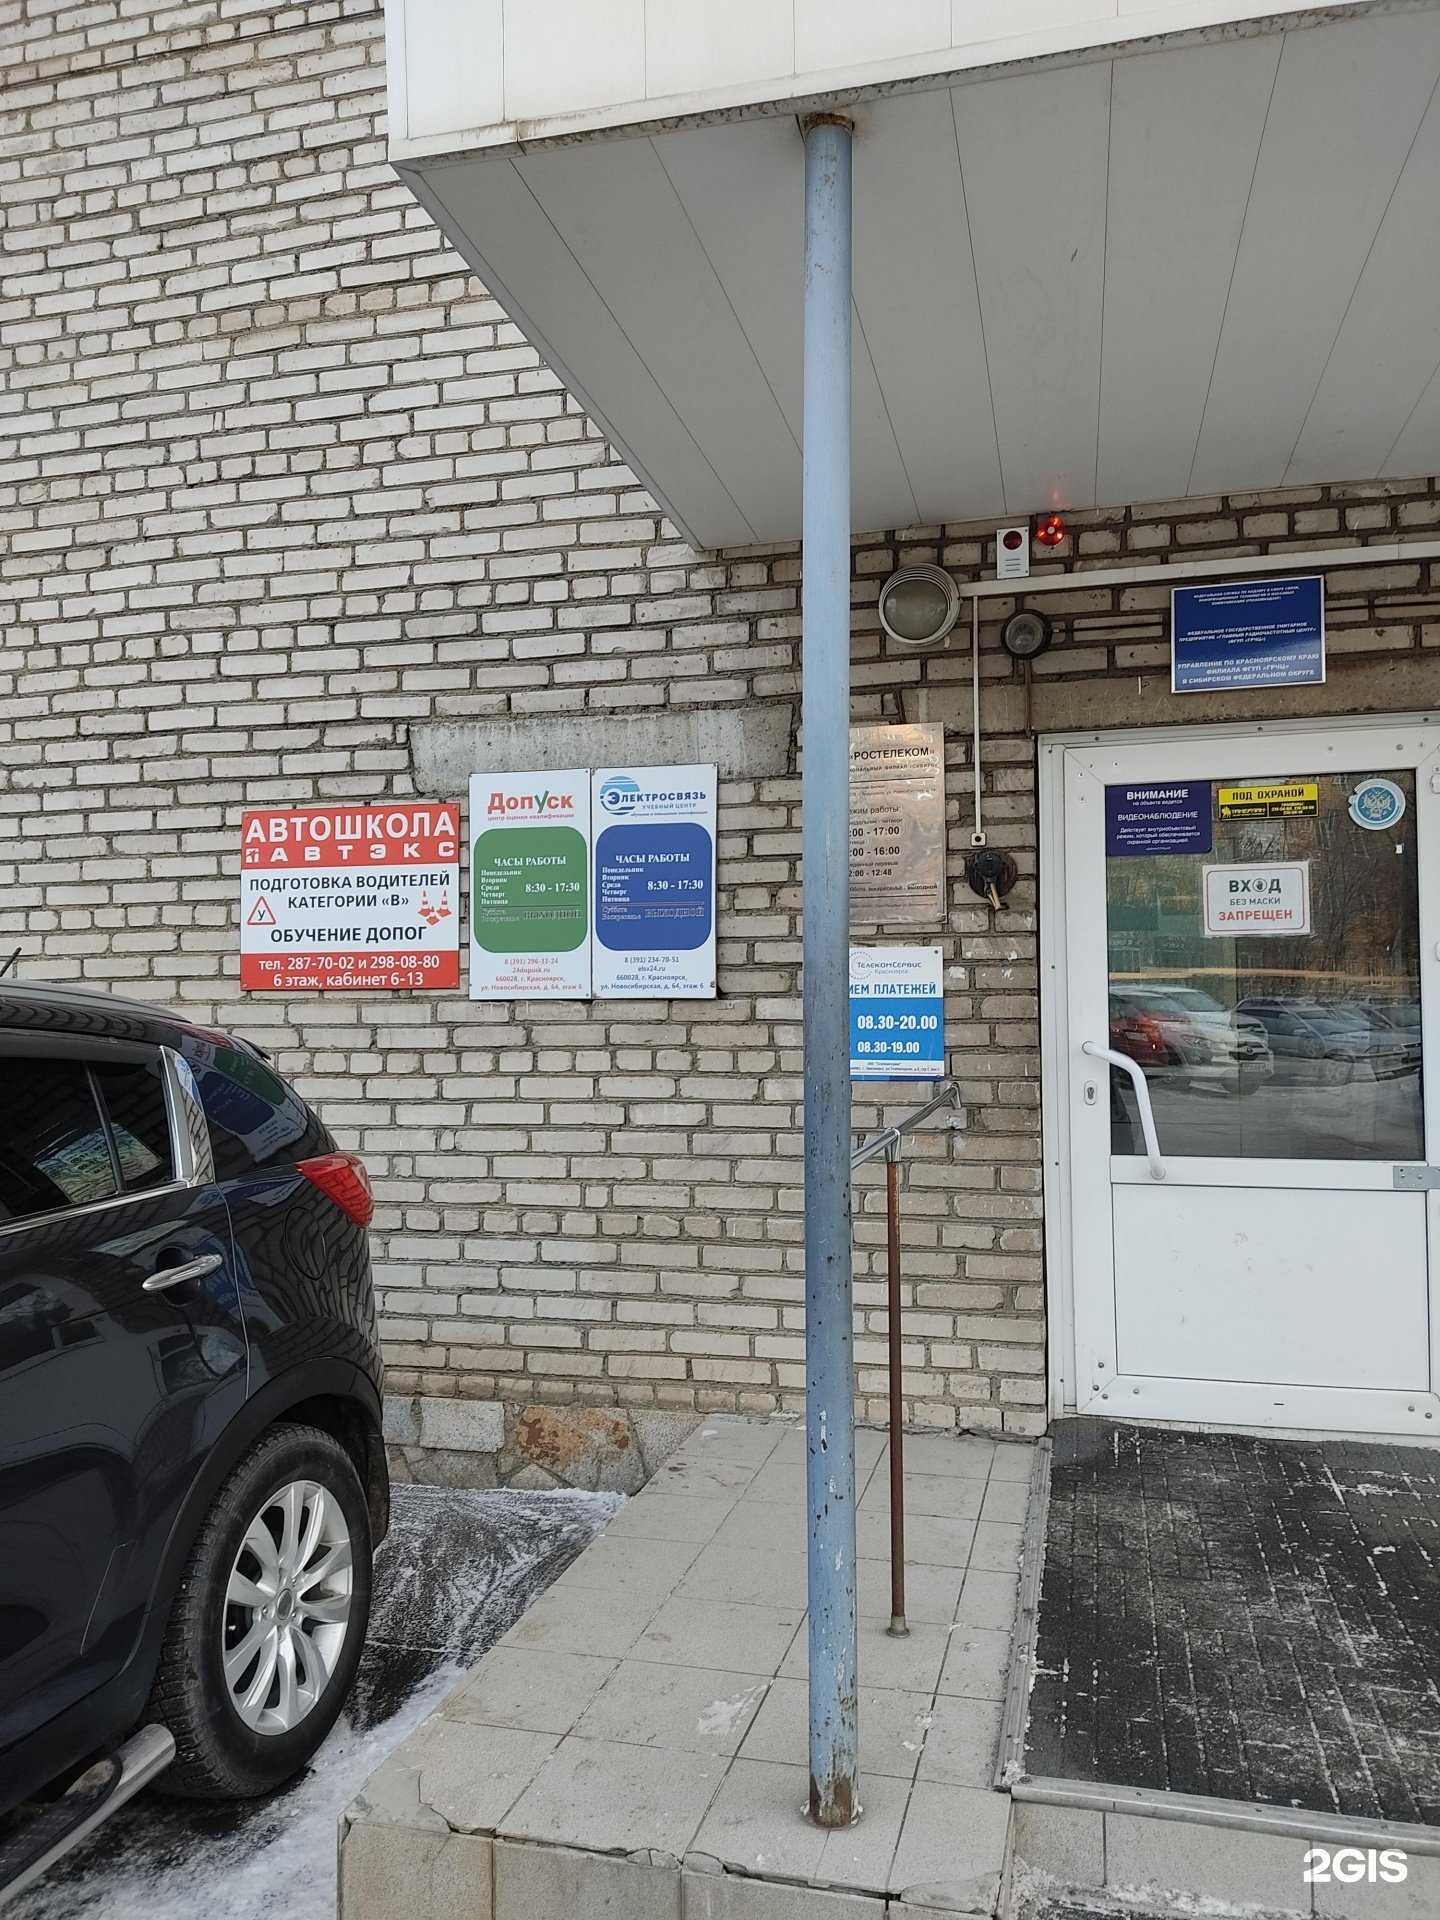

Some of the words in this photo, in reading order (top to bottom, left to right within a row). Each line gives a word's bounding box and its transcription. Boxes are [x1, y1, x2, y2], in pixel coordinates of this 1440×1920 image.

[607, 791, 706, 805] ЭЛЕКТРОСВЯЗЬ
[1126, 789, 1188, 800] ВНИМАНИЕ
[1232, 792, 1252, 800] ПОД
[1258, 788, 1304, 799] ОХРАНОЙ
[1117, 811, 1199, 821] ВИДЕОНАБЛЮДЕНИЕ
[245, 811, 455, 843] АВТОШКОЛА
[849, 828, 864, 837] :00
[873, 826, 899, 836] 17:00
[850, 848, 864, 856] :00
[874, 846, 900, 855] 16:00
[494, 858, 523, 867] ЧАСЫ
[526, 856, 566, 866] РАБОТЫ
[615, 855, 645, 864] ЧАСЫ
[648, 853, 689, 863] РАБОТЫ
[849, 869, 864, 877] 2:00
[250, 876, 351, 893] ПОДГОТОВКА
[357, 870, 450, 890] ВОДИТЕЛЕЙ
[525, 883, 545, 892] 8:30
[555, 882, 580, 892] 17:30
[647, 881, 668, 890] 8:30
[678, 880, 703, 890] 17:30
[288, 895, 377, 909] КАТЕГОРИИ
[382, 894, 409, 907] «В»
[1230, 898, 1247, 906] БЕЗ
[1249, 897, 1280, 905] МАСКИ
[1219, 910, 1292, 921] ЗАПРЕЩЕН
[271, 928, 361, 943] ОБУЧЕНИЕ
[366, 926, 427, 944] ДОПОГ
[259, 959, 284, 970] тел.
[287, 957, 354, 970] 287-70-02
[358, 960, 367, 969] и
[370, 955, 439, 968] 298-08-80
[273, 974, 282, 986] 6
[285, 975, 322, 988] этаж,
[326, 973, 387, 986] кабинет
[391, 972, 424, 985] 6-13
[849, 984, 869, 994] ИЕМ
[874, 981, 936, 994] ПЛАТЕЖЕЙ
[857, 1015, 938, 1030] 08.30-20.00
[857, 1041, 920, 1053] 08.30-19.00
